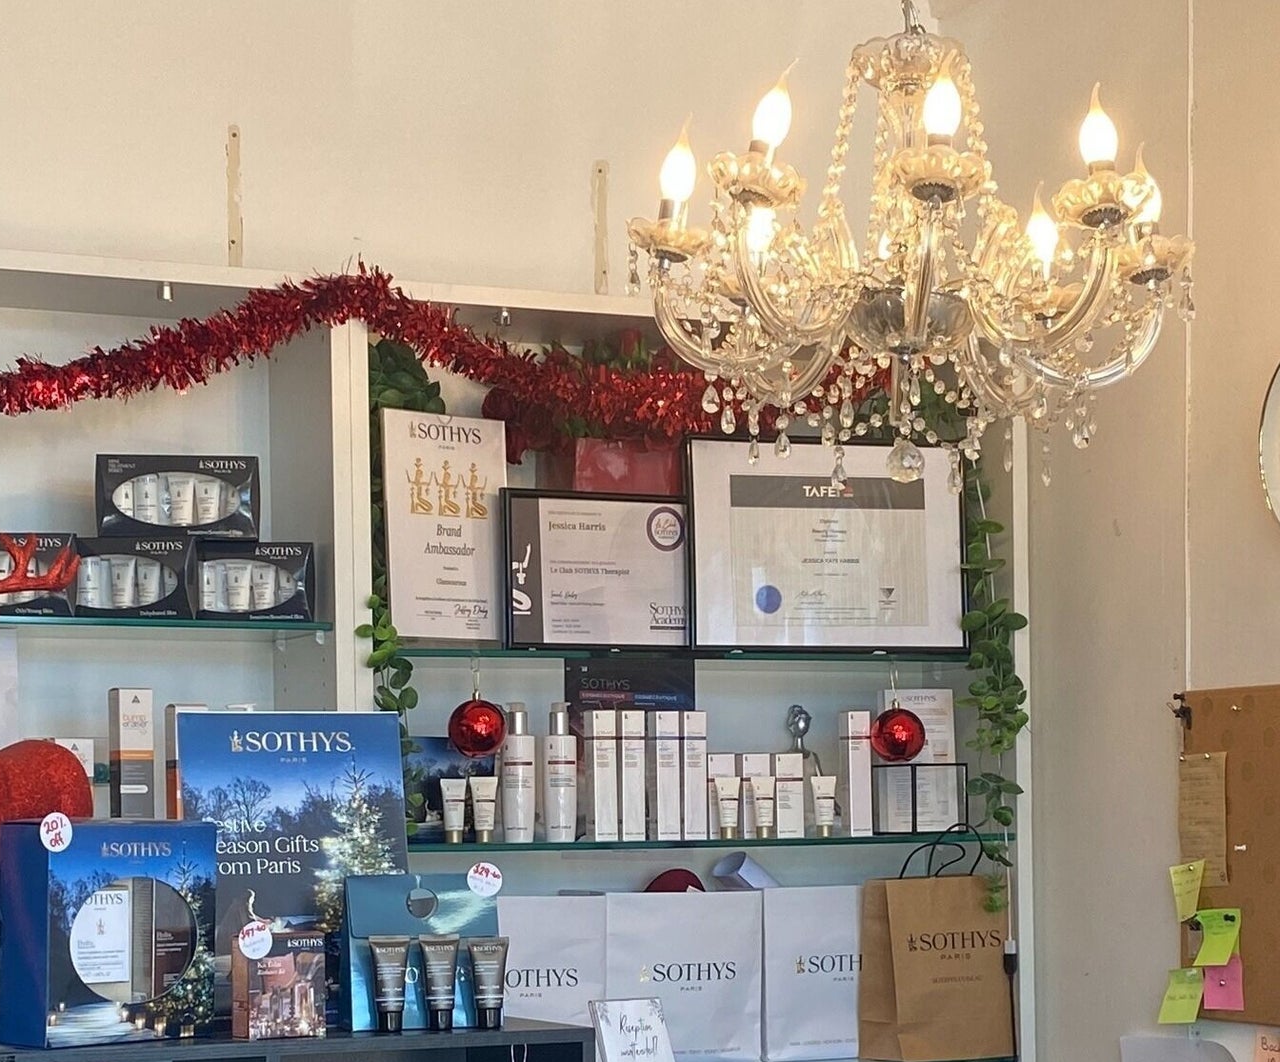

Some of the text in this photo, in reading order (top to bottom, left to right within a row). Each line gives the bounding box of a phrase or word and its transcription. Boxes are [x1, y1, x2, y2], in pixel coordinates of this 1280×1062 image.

[418, 423, 481, 444] SOTHYS
[205, 460, 246, 470] SOTHYS
[436, 524, 462, 538] Brand
[548, 521, 606, 531] Jessica Harris
[16, 537, 62, 548] STHYS
[141, 541, 183, 550] SOTHYS
[424, 542, 476, 557] Ambassador
[260, 547, 302, 556] SOTHYS
[650, 602, 686, 615] SOTHYS
[581, 678, 630, 691] SOTHYS
[245, 731, 352, 752] SOTHYS
[208, 818, 266, 834] estive
[50, 833, 65, 848] off
[216, 835, 319, 853] eason Gifts
[110, 842, 170, 857] SOTHYS
[216, 858, 300, 875] om Paris
[85, 893, 123, 906] OTHYS
[291, 939, 323, 947] SOTHYS
[919, 930, 1002, 951] SOTHYS
[653, 962, 736, 983] SOTHYS
[807, 955, 862, 975] SOTH
[506, 969, 578, 988] OTHYS
[620, 1014, 652, 1040] Reception
